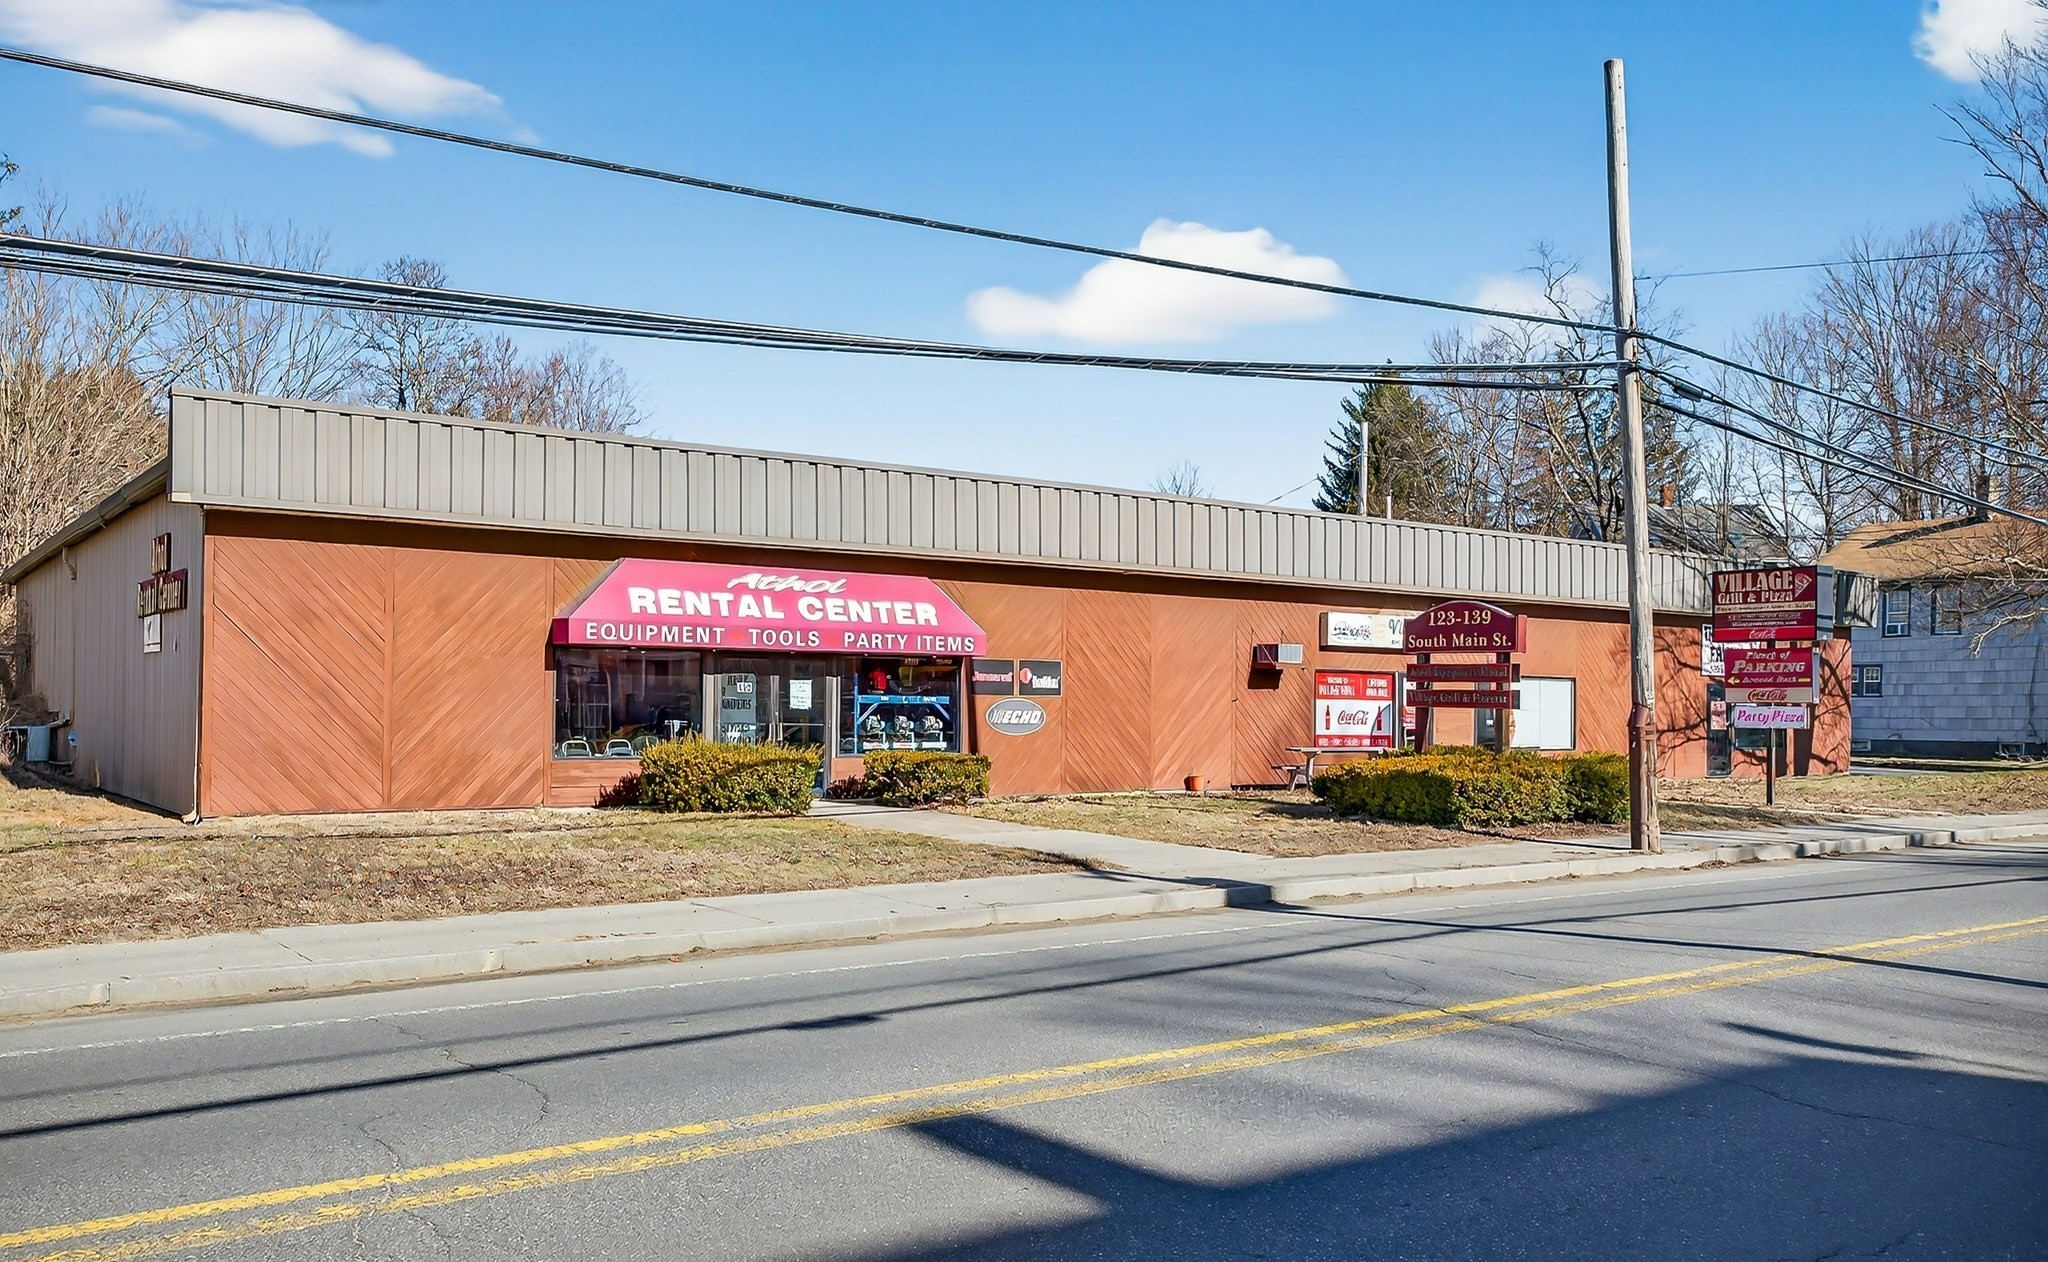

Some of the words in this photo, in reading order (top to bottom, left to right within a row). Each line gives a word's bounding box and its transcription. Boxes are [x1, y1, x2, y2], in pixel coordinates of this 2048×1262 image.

[726, 572, 848, 594] Athol
[1717, 570, 1793, 593] VILLAGE
[628, 586, 786, 619] RENTAL
[797, 596, 939, 626] CENTER
[1428, 609, 1492, 626] 123-139
[586, 622, 726, 645] EQUIPMENT
[748, 628, 820, 647] TOOLS
[844, 631, 909, 650] PARTY
[917, 635, 975, 652] ITEMS
[1408, 634, 1447, 648] South
[1452, 632, 1488, 647] Main
[1492, 632, 1512, 646] St.
[1731, 660, 1806, 674] PARKING
[1737, 709, 1770, 725] Party
